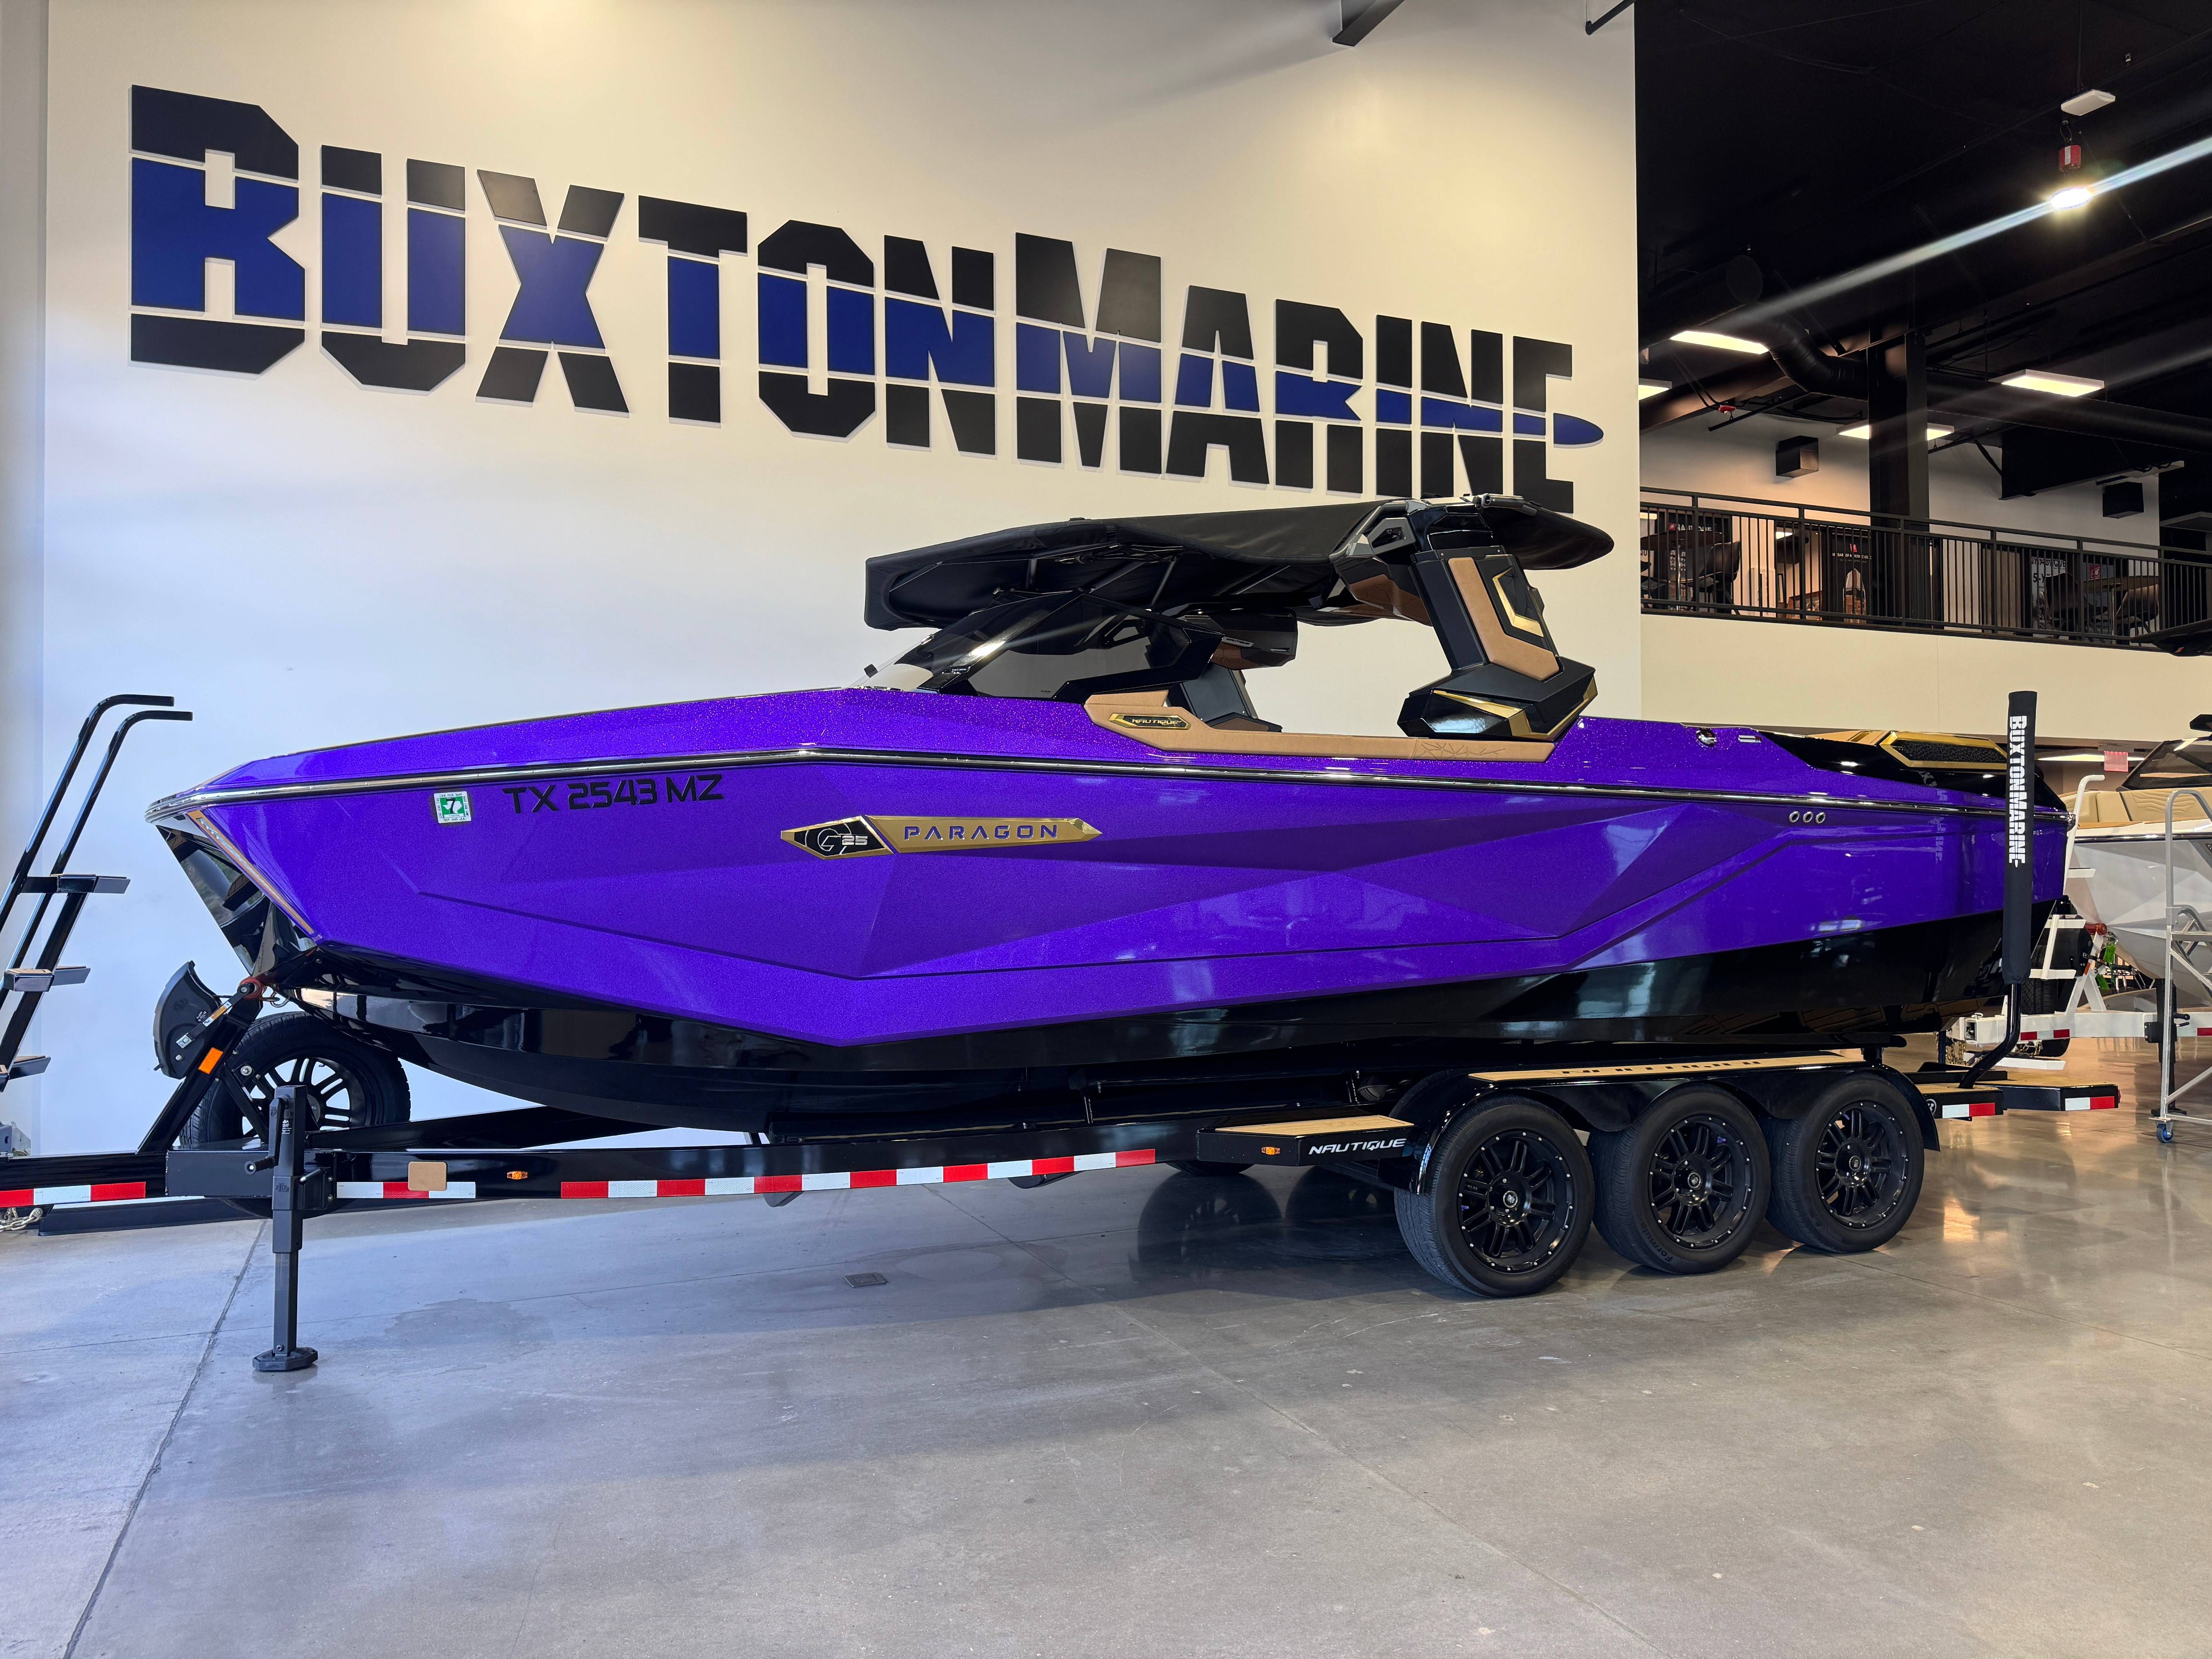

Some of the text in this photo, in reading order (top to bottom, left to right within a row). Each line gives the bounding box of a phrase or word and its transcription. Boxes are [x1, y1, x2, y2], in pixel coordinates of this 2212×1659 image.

[1132, 718, 1182, 726] NAUTIQUE
[503, 785, 559, 814] TX
[568, 779, 658, 810] 2543
[665, 774, 724, 803] MZ
[446, 797, 456, 814] 7
[904, 824, 1058, 841] PARAGON
[1309, 1138, 1407, 1155] NAUTIQUE
